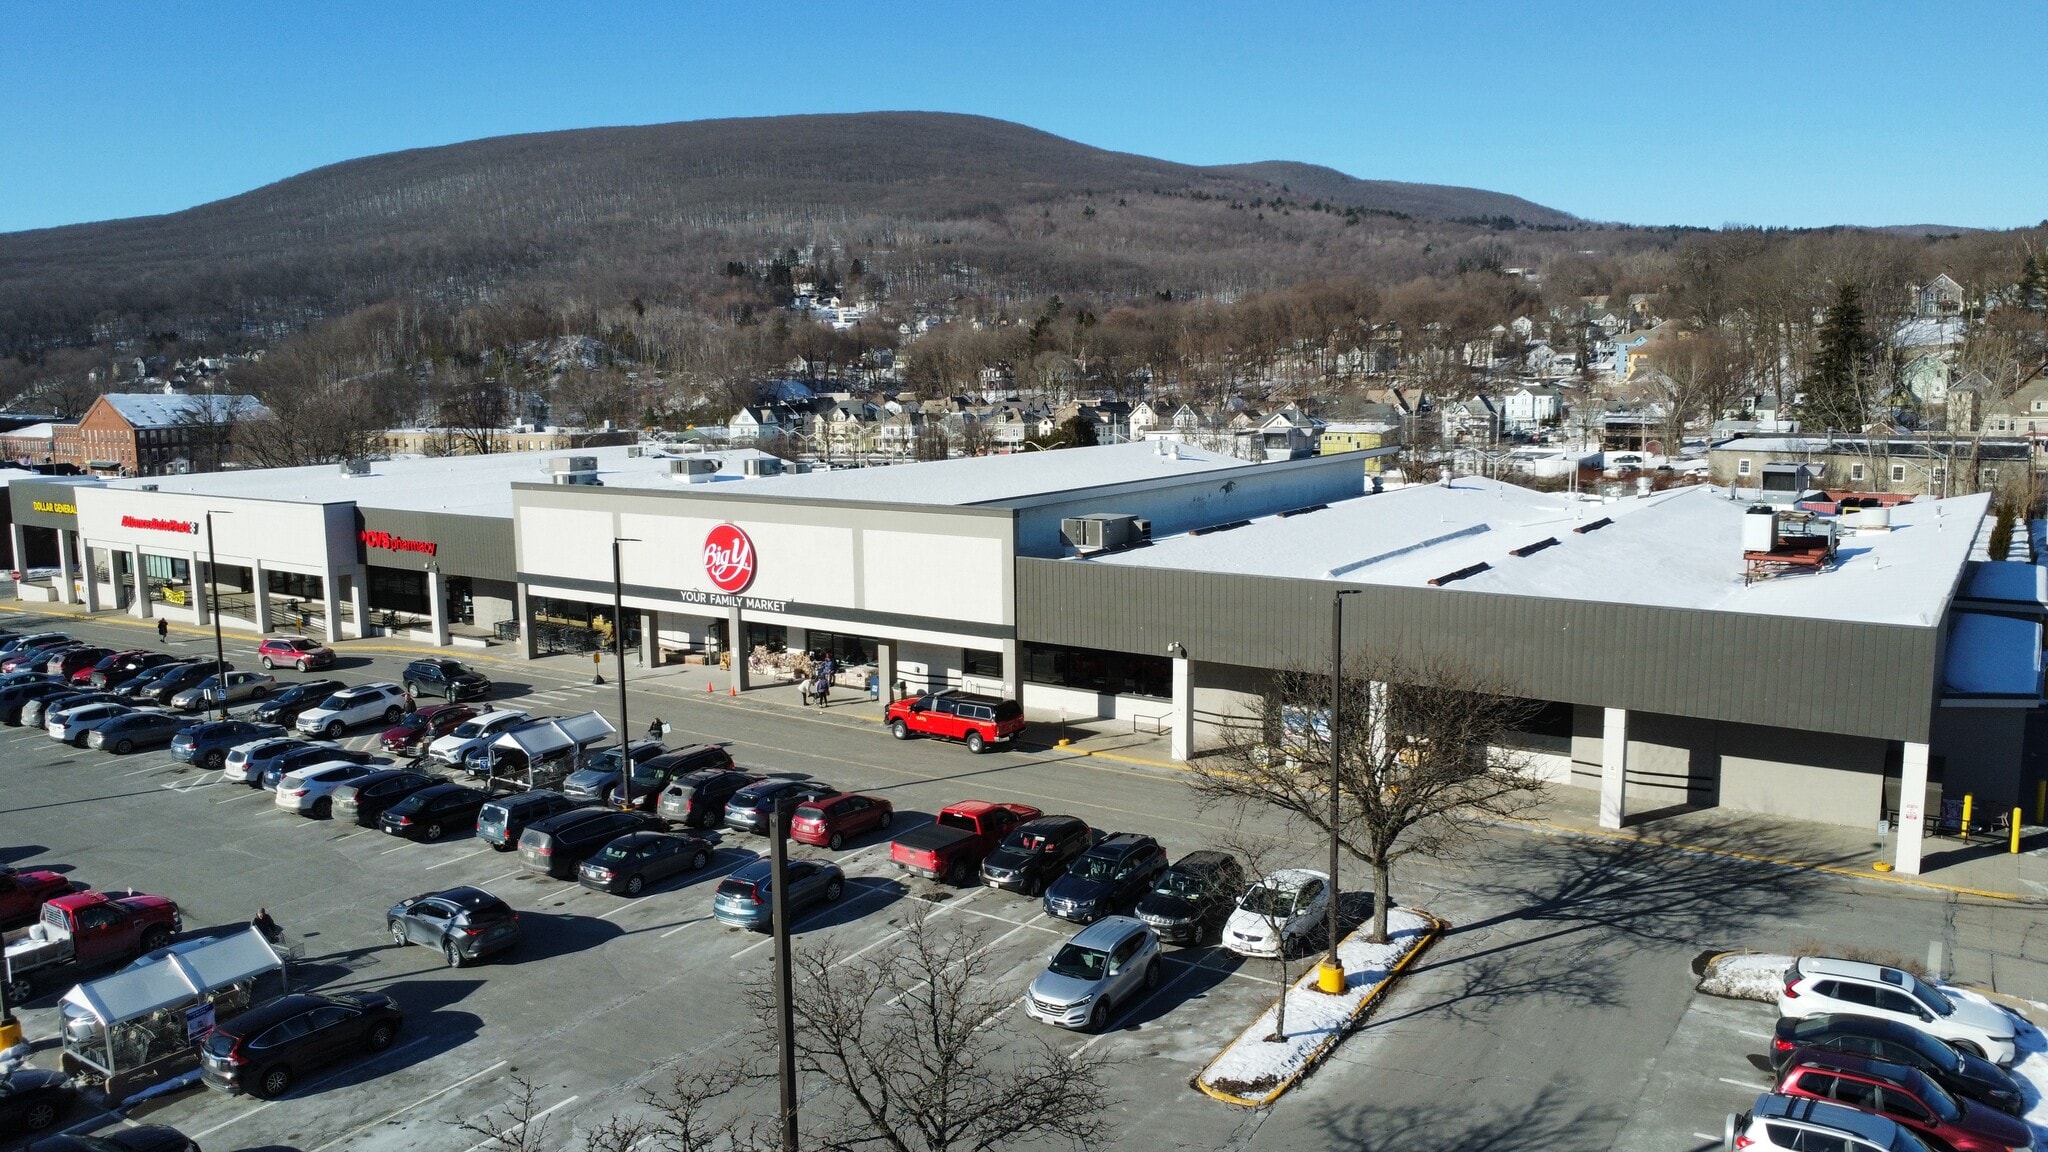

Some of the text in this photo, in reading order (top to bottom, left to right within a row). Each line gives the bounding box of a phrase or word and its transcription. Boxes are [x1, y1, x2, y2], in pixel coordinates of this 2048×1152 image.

[32, 501, 78, 514] DOLLAR GENERAL
[366, 530, 437, 556] CVS pharmacy
[704, 543, 731, 573] Big
[680, 590, 787, 612] YOUR FAMILY MARKET
